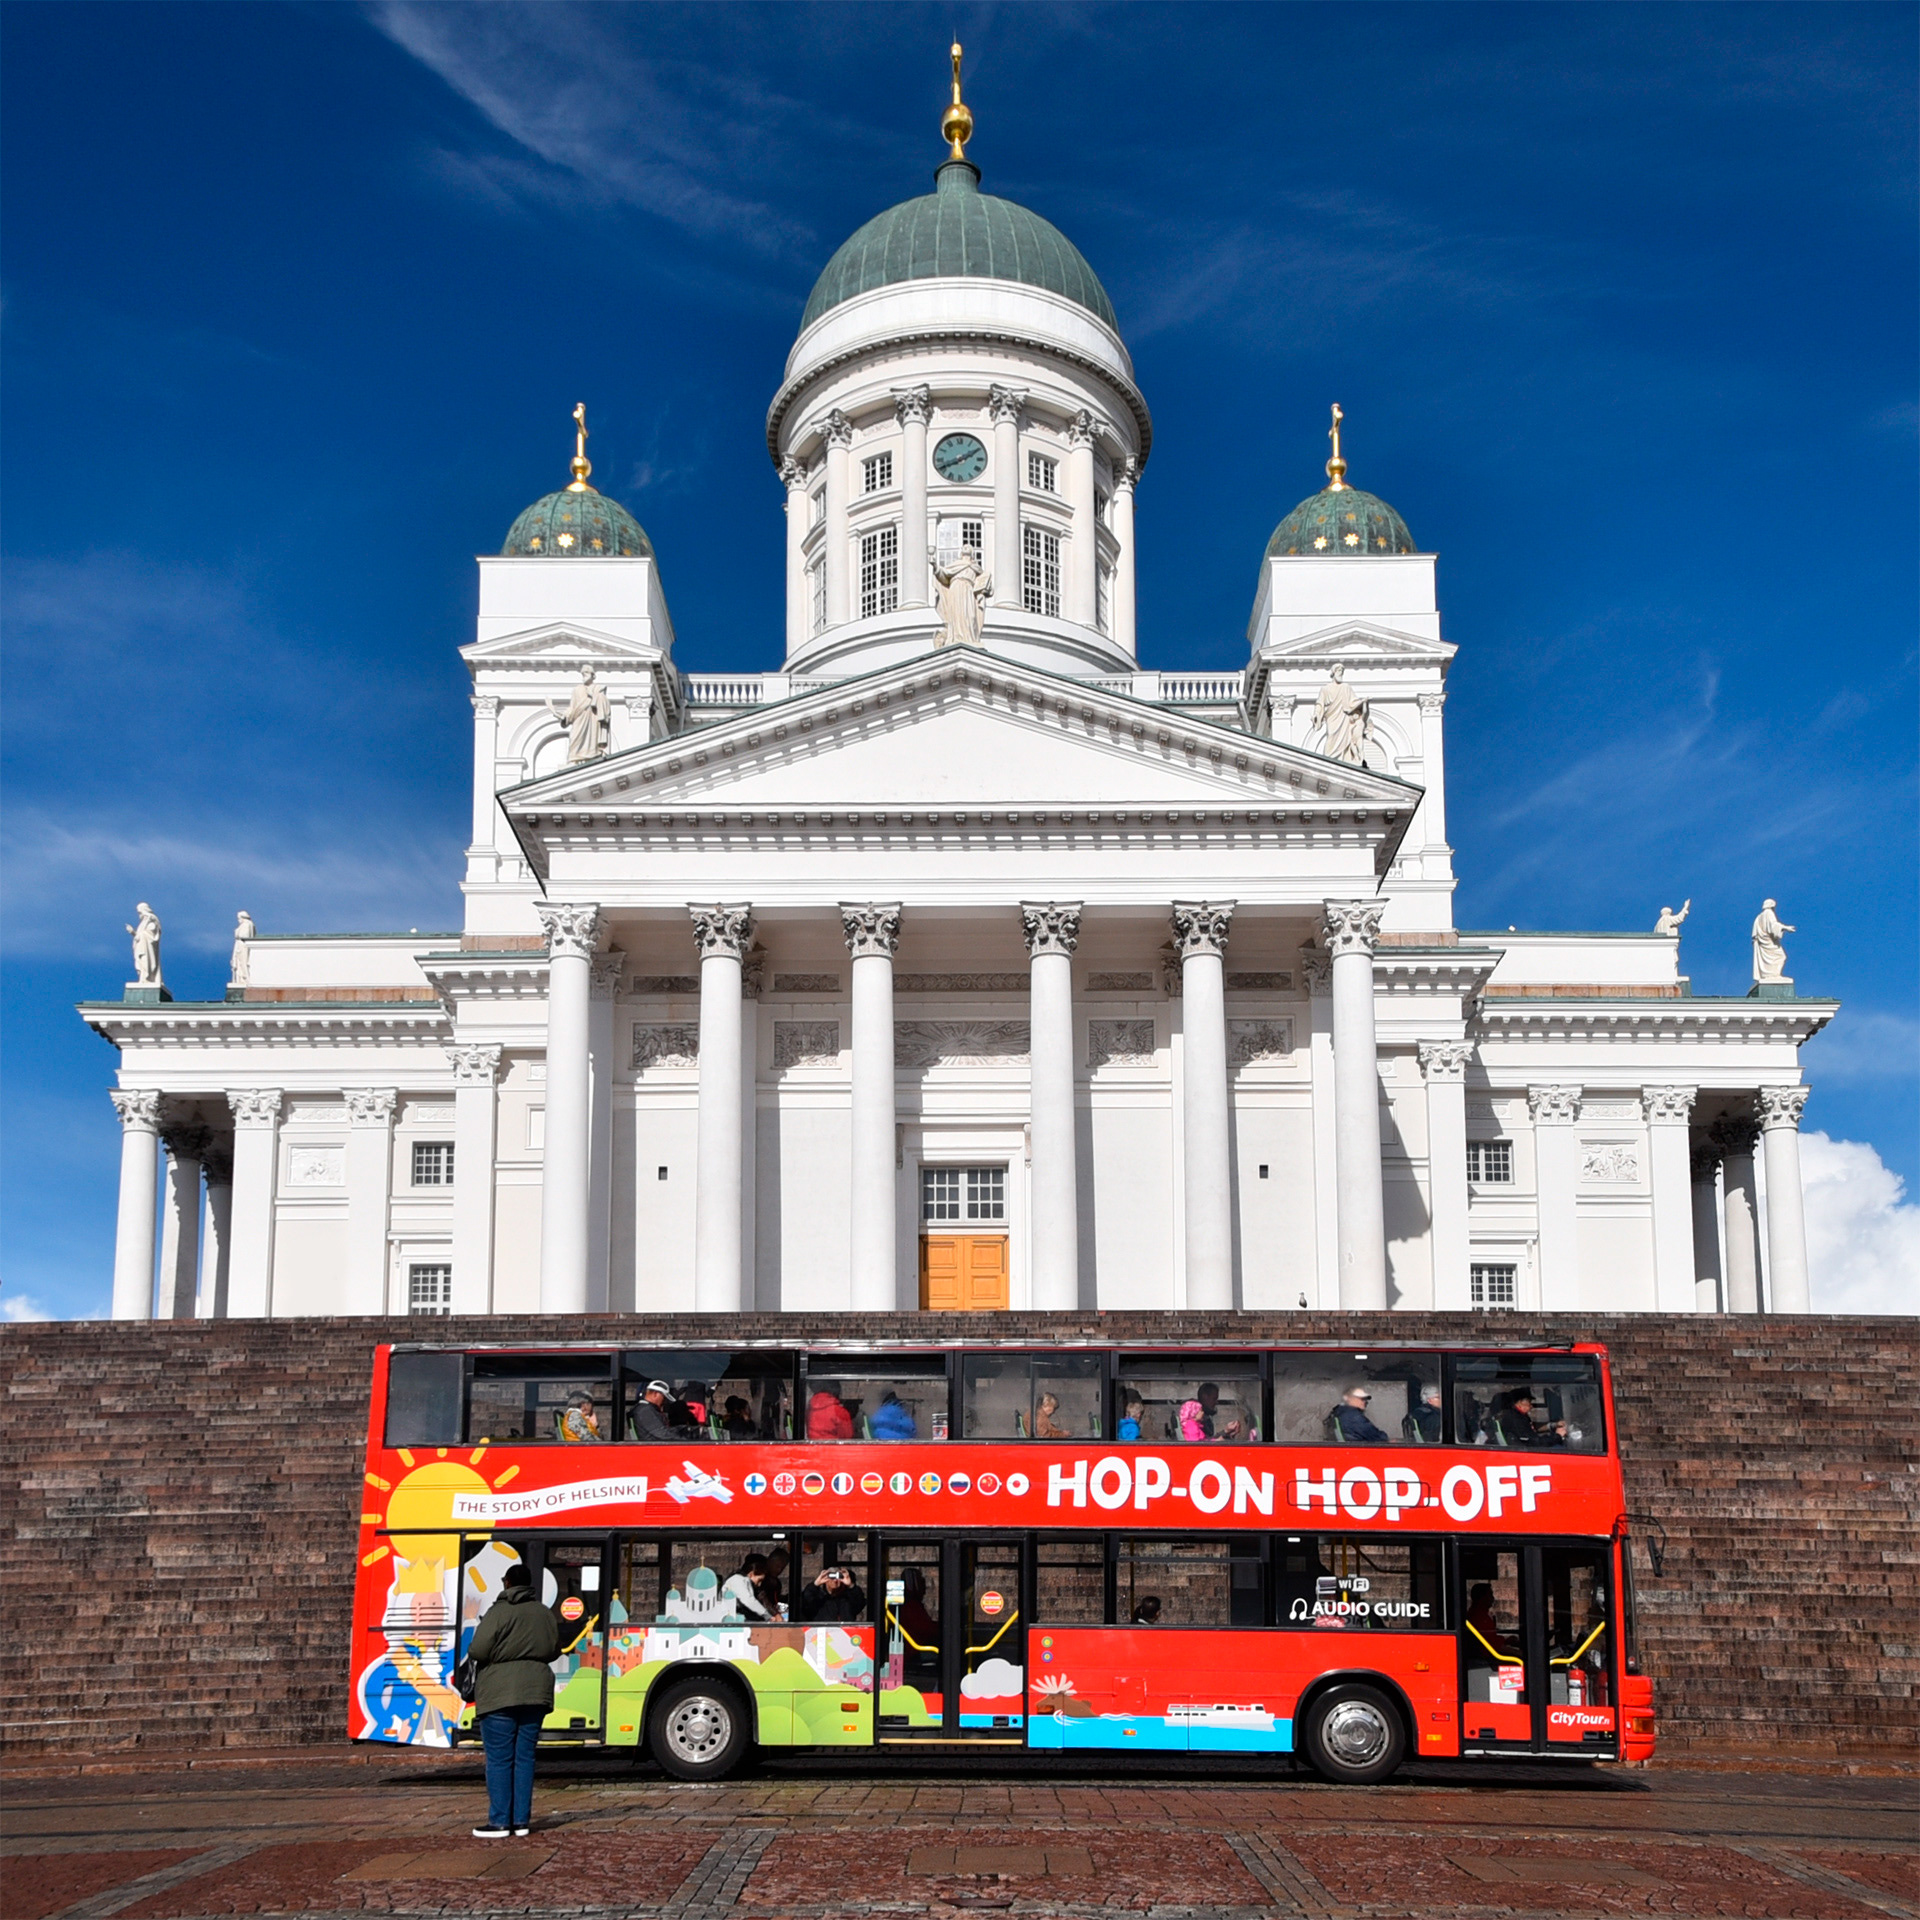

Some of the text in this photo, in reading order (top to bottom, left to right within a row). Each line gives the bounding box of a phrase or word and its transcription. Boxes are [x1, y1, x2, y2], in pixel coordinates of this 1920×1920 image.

[459, 1484, 641, 1513] THE STORY OF HELSINKI
[1047, 1456, 1552, 1522] HOP-ON HOP-OFF
[1311, 1601, 1431, 1618] AUDIO GUIDE
